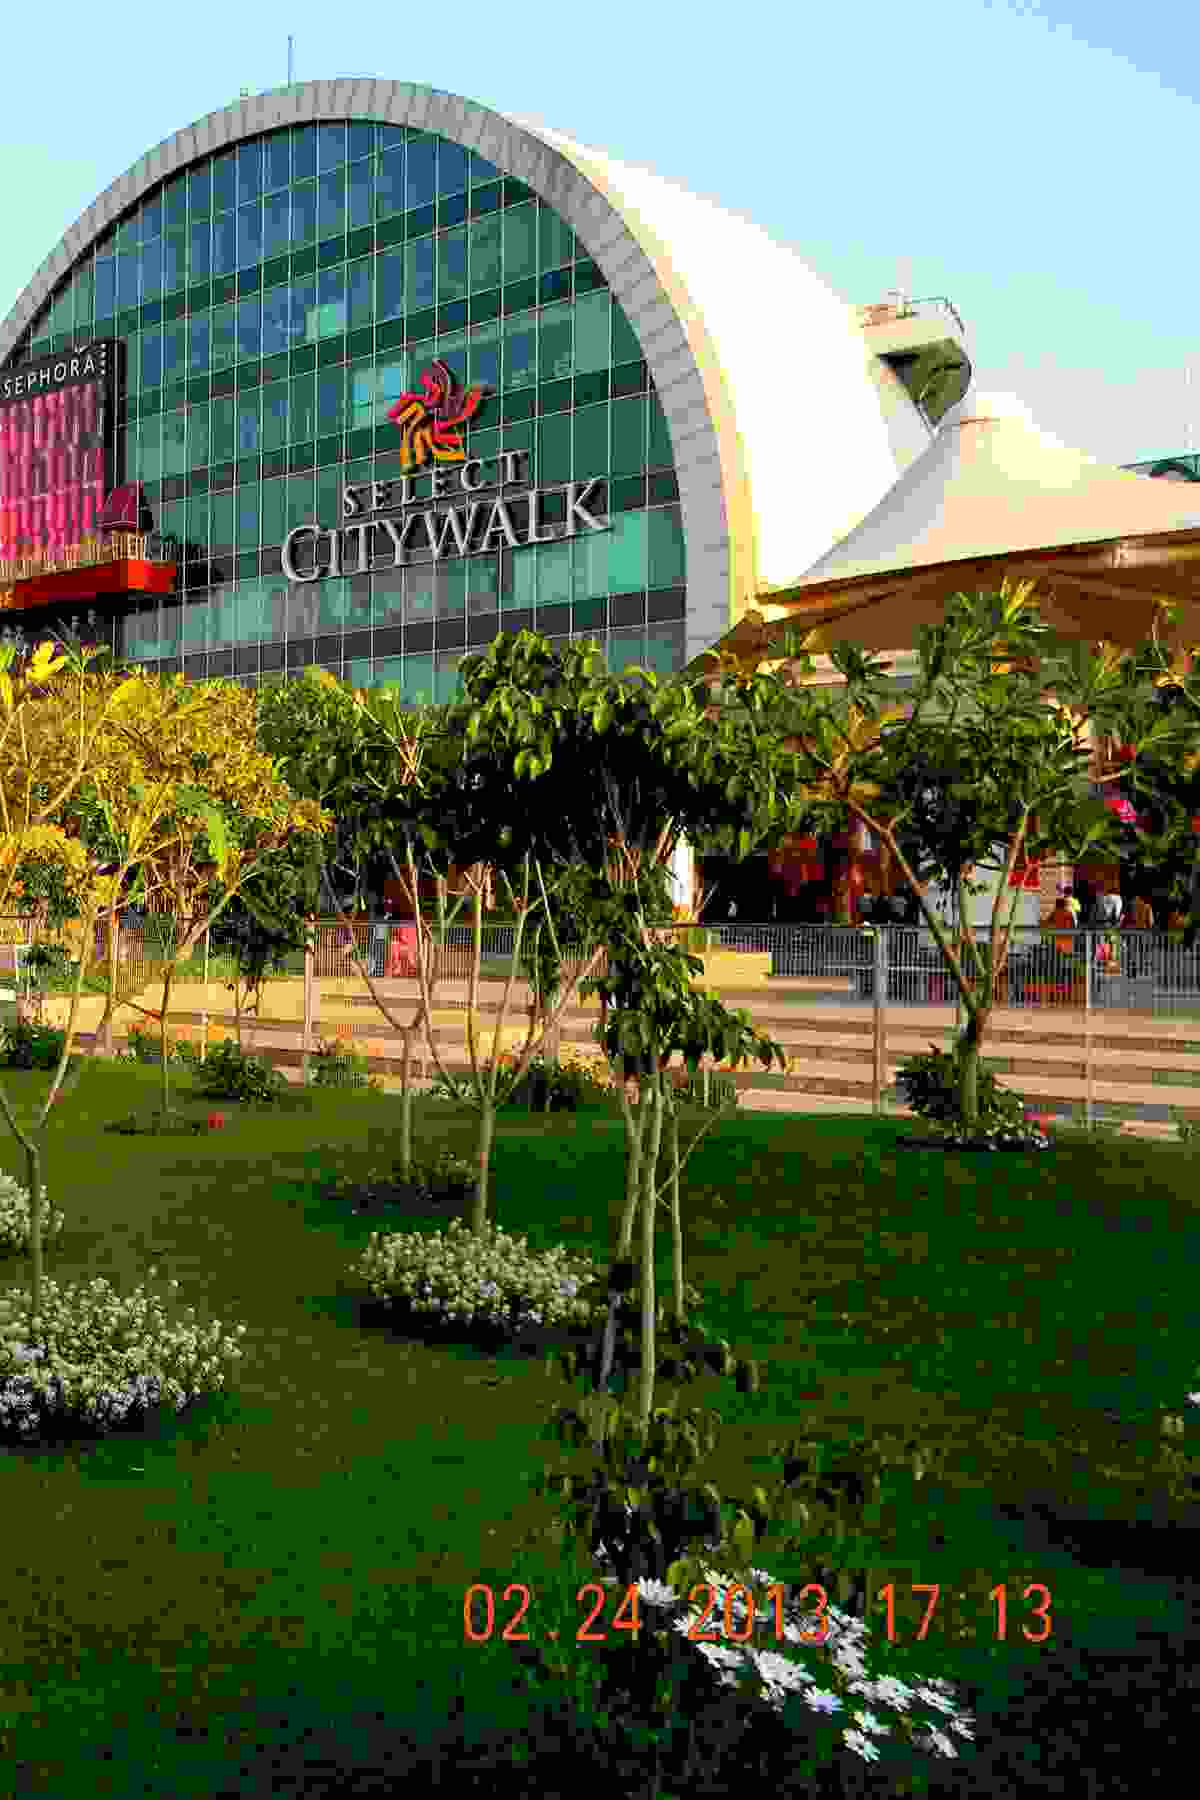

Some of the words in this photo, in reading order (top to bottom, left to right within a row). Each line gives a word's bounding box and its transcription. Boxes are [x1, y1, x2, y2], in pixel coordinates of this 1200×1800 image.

[2, 354, 96, 398] SEPHORA
[343, 449, 527, 517] SELECT
[281, 477, 610, 583] CITYWALK
